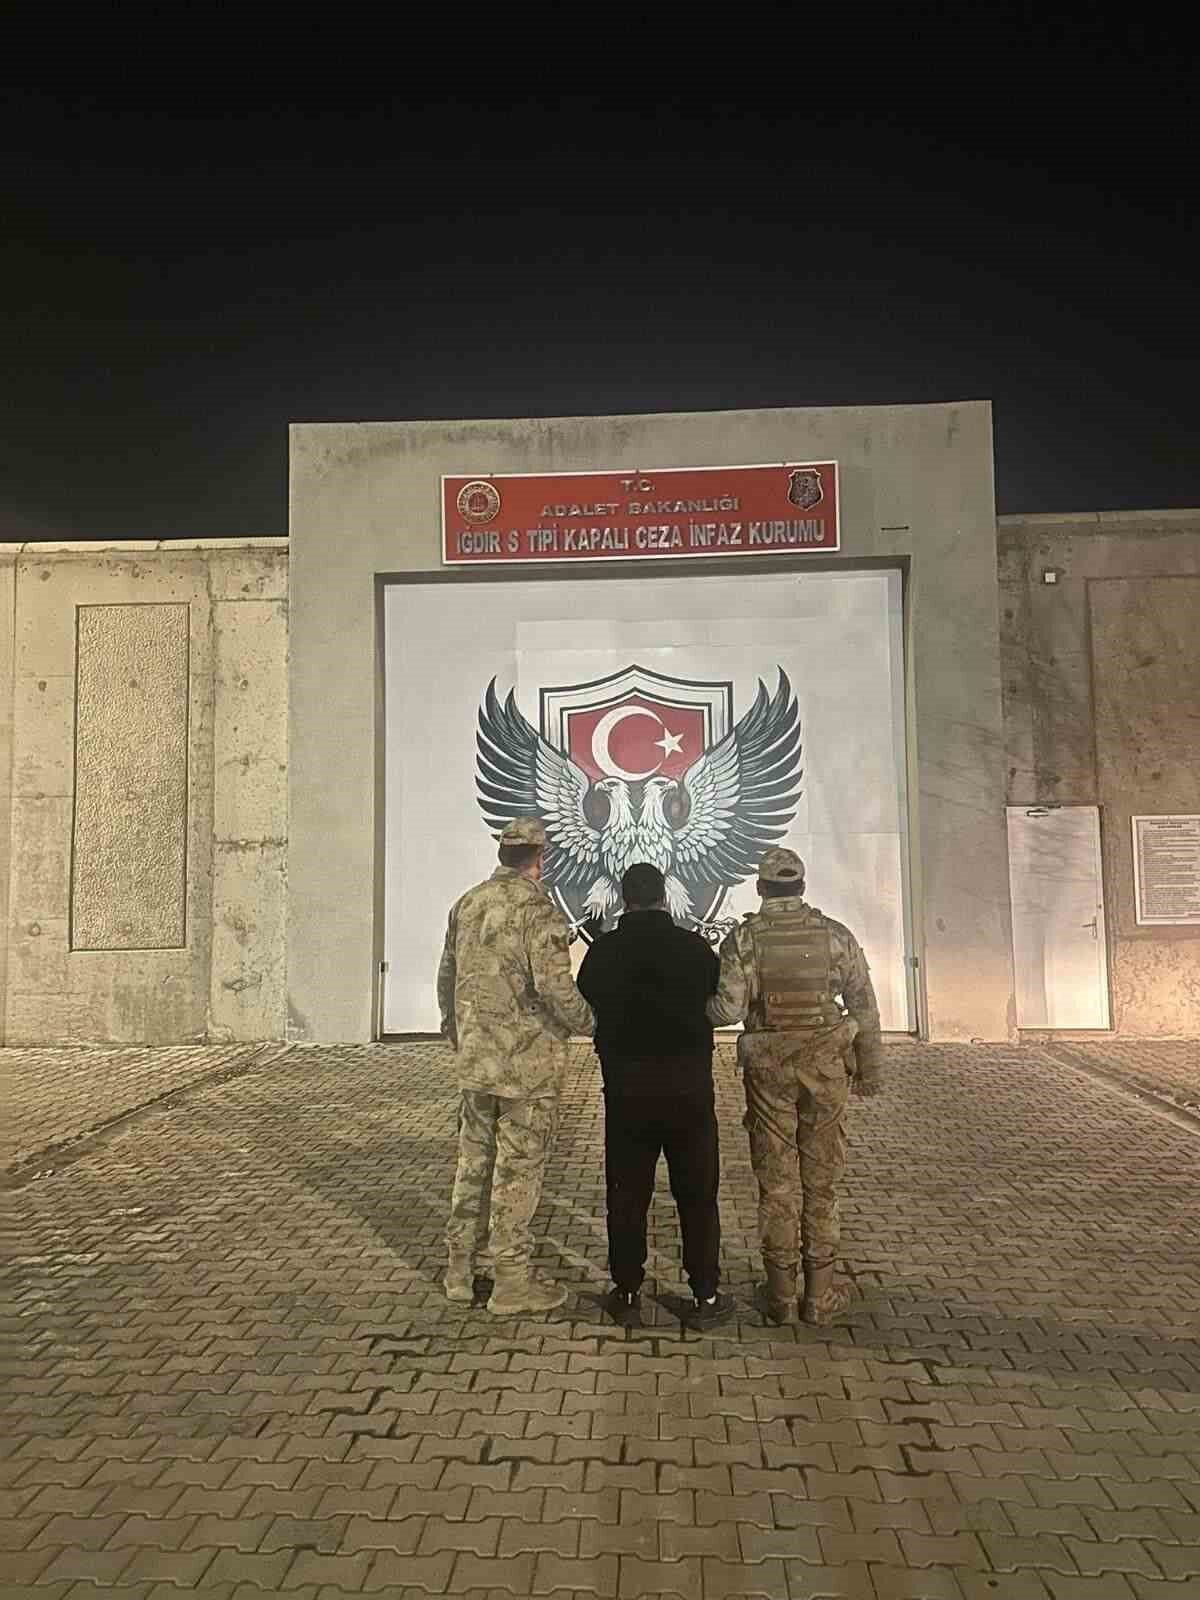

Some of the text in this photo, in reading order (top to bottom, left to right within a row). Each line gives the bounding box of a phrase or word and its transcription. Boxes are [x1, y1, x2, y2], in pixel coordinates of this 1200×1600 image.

[540, 494, 740, 517] ADALET BAKANLIĞI
[508, 529, 519, 553] S
[527, 523, 558, 553] TİPİ
[564, 527, 628, 551] KAPALI
[636, 525, 683, 549] CEZA
[689, 517, 742, 547] İNFAZ
[750, 519, 825, 546] KURUMU
